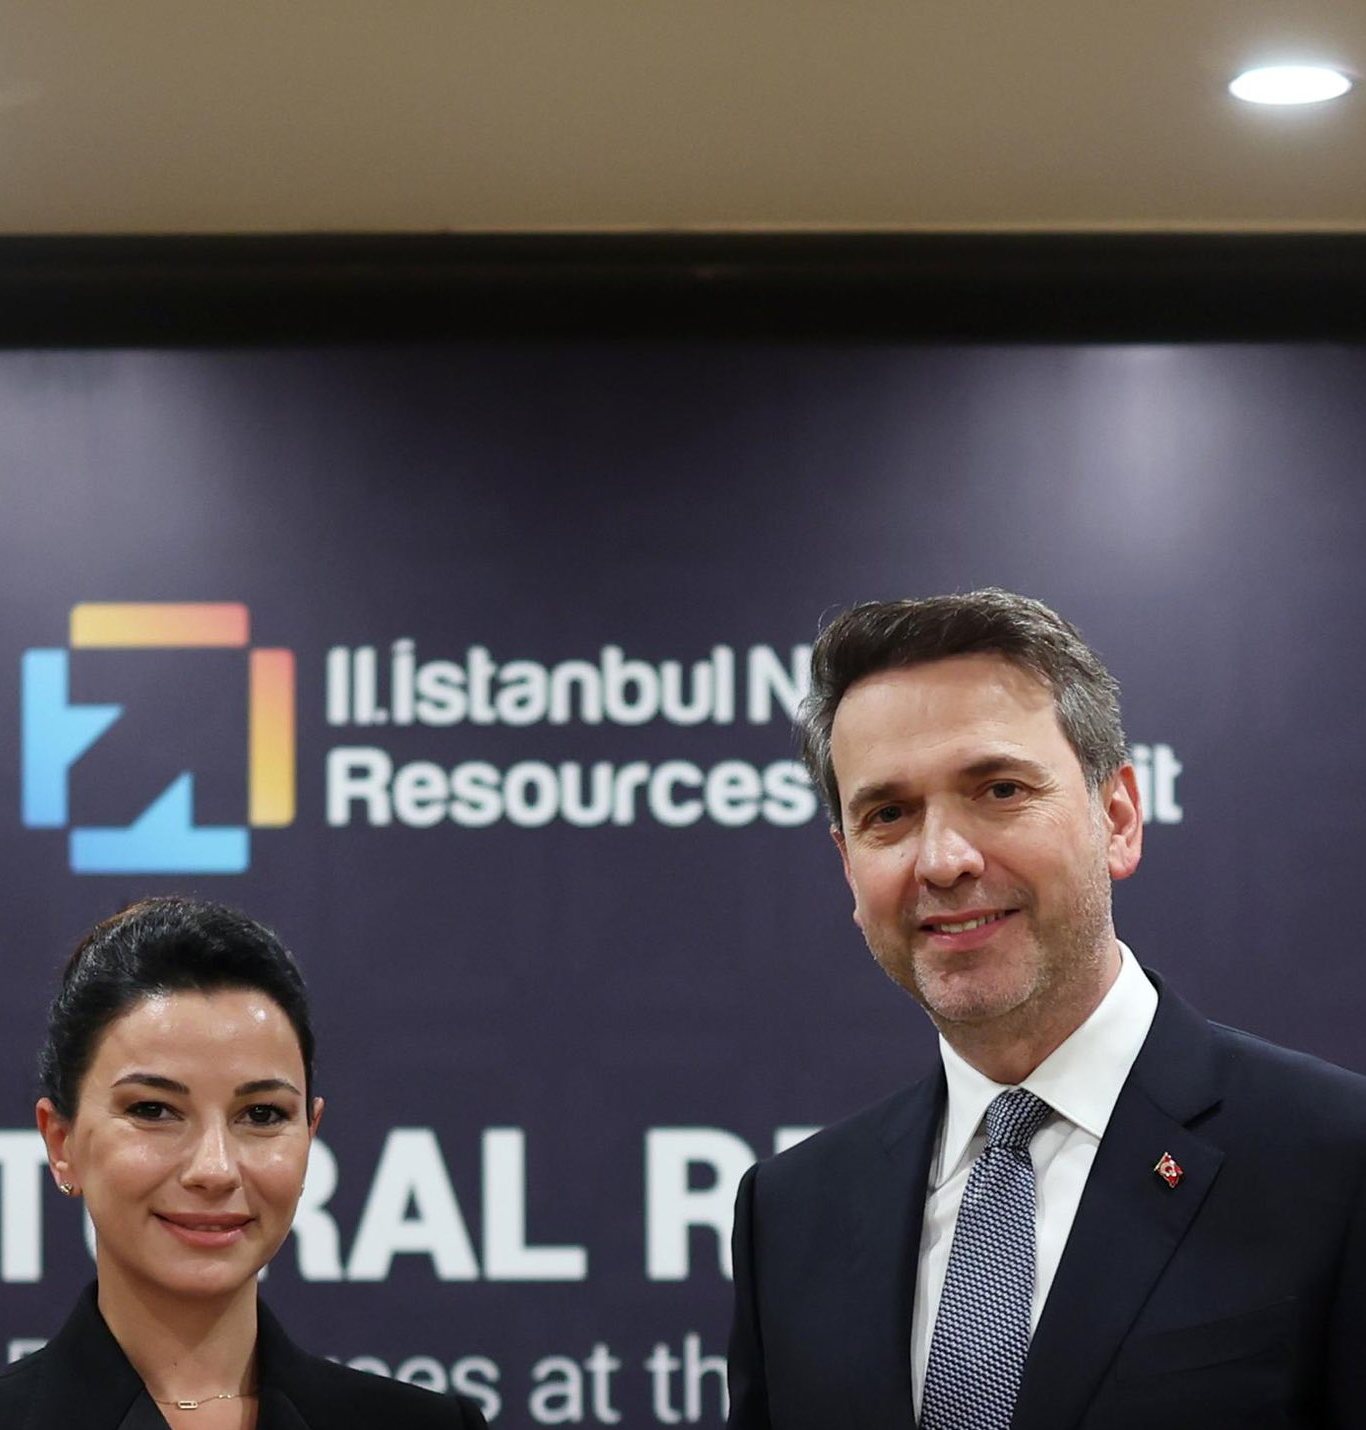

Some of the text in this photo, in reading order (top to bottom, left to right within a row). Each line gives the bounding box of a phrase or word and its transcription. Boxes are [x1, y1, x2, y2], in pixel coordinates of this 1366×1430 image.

[325, 745, 817, 828] Resources
[529, 1344, 620, 1424] at
[646, 1333, 729, 1424] th
